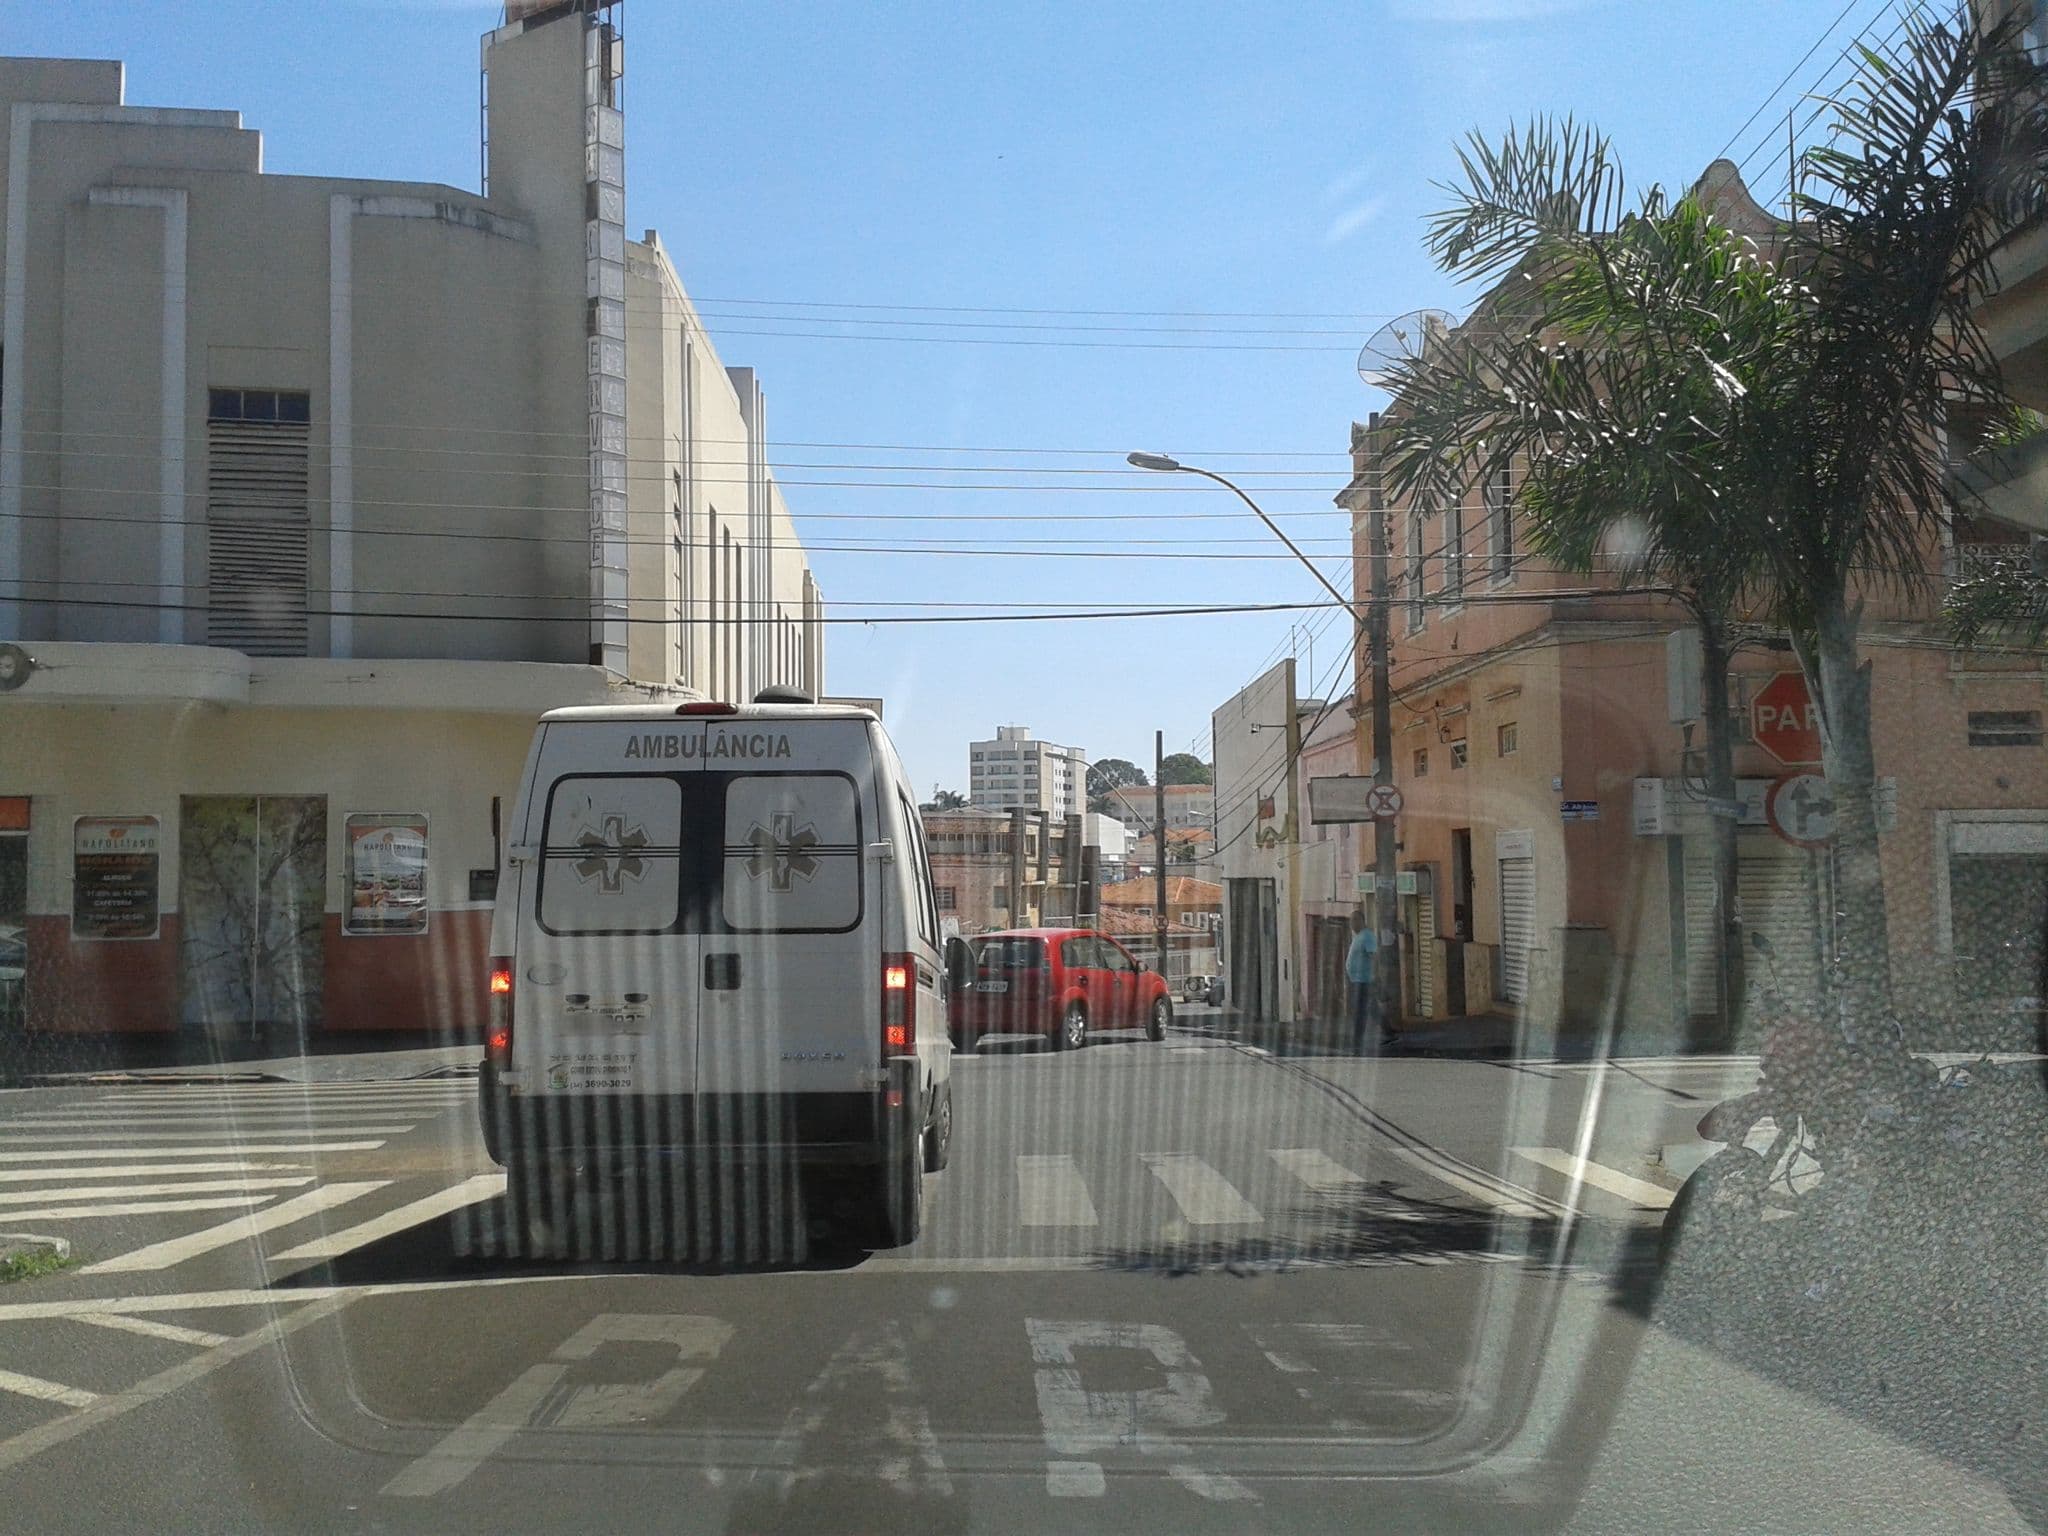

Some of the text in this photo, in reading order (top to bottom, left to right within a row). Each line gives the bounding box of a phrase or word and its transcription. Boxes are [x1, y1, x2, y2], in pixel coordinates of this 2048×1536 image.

[1758, 704, 1818, 732] PAR
[624, 729, 791, 758] AMBULÂNCIA
[82, 838, 155, 849] NAPOLITANO
